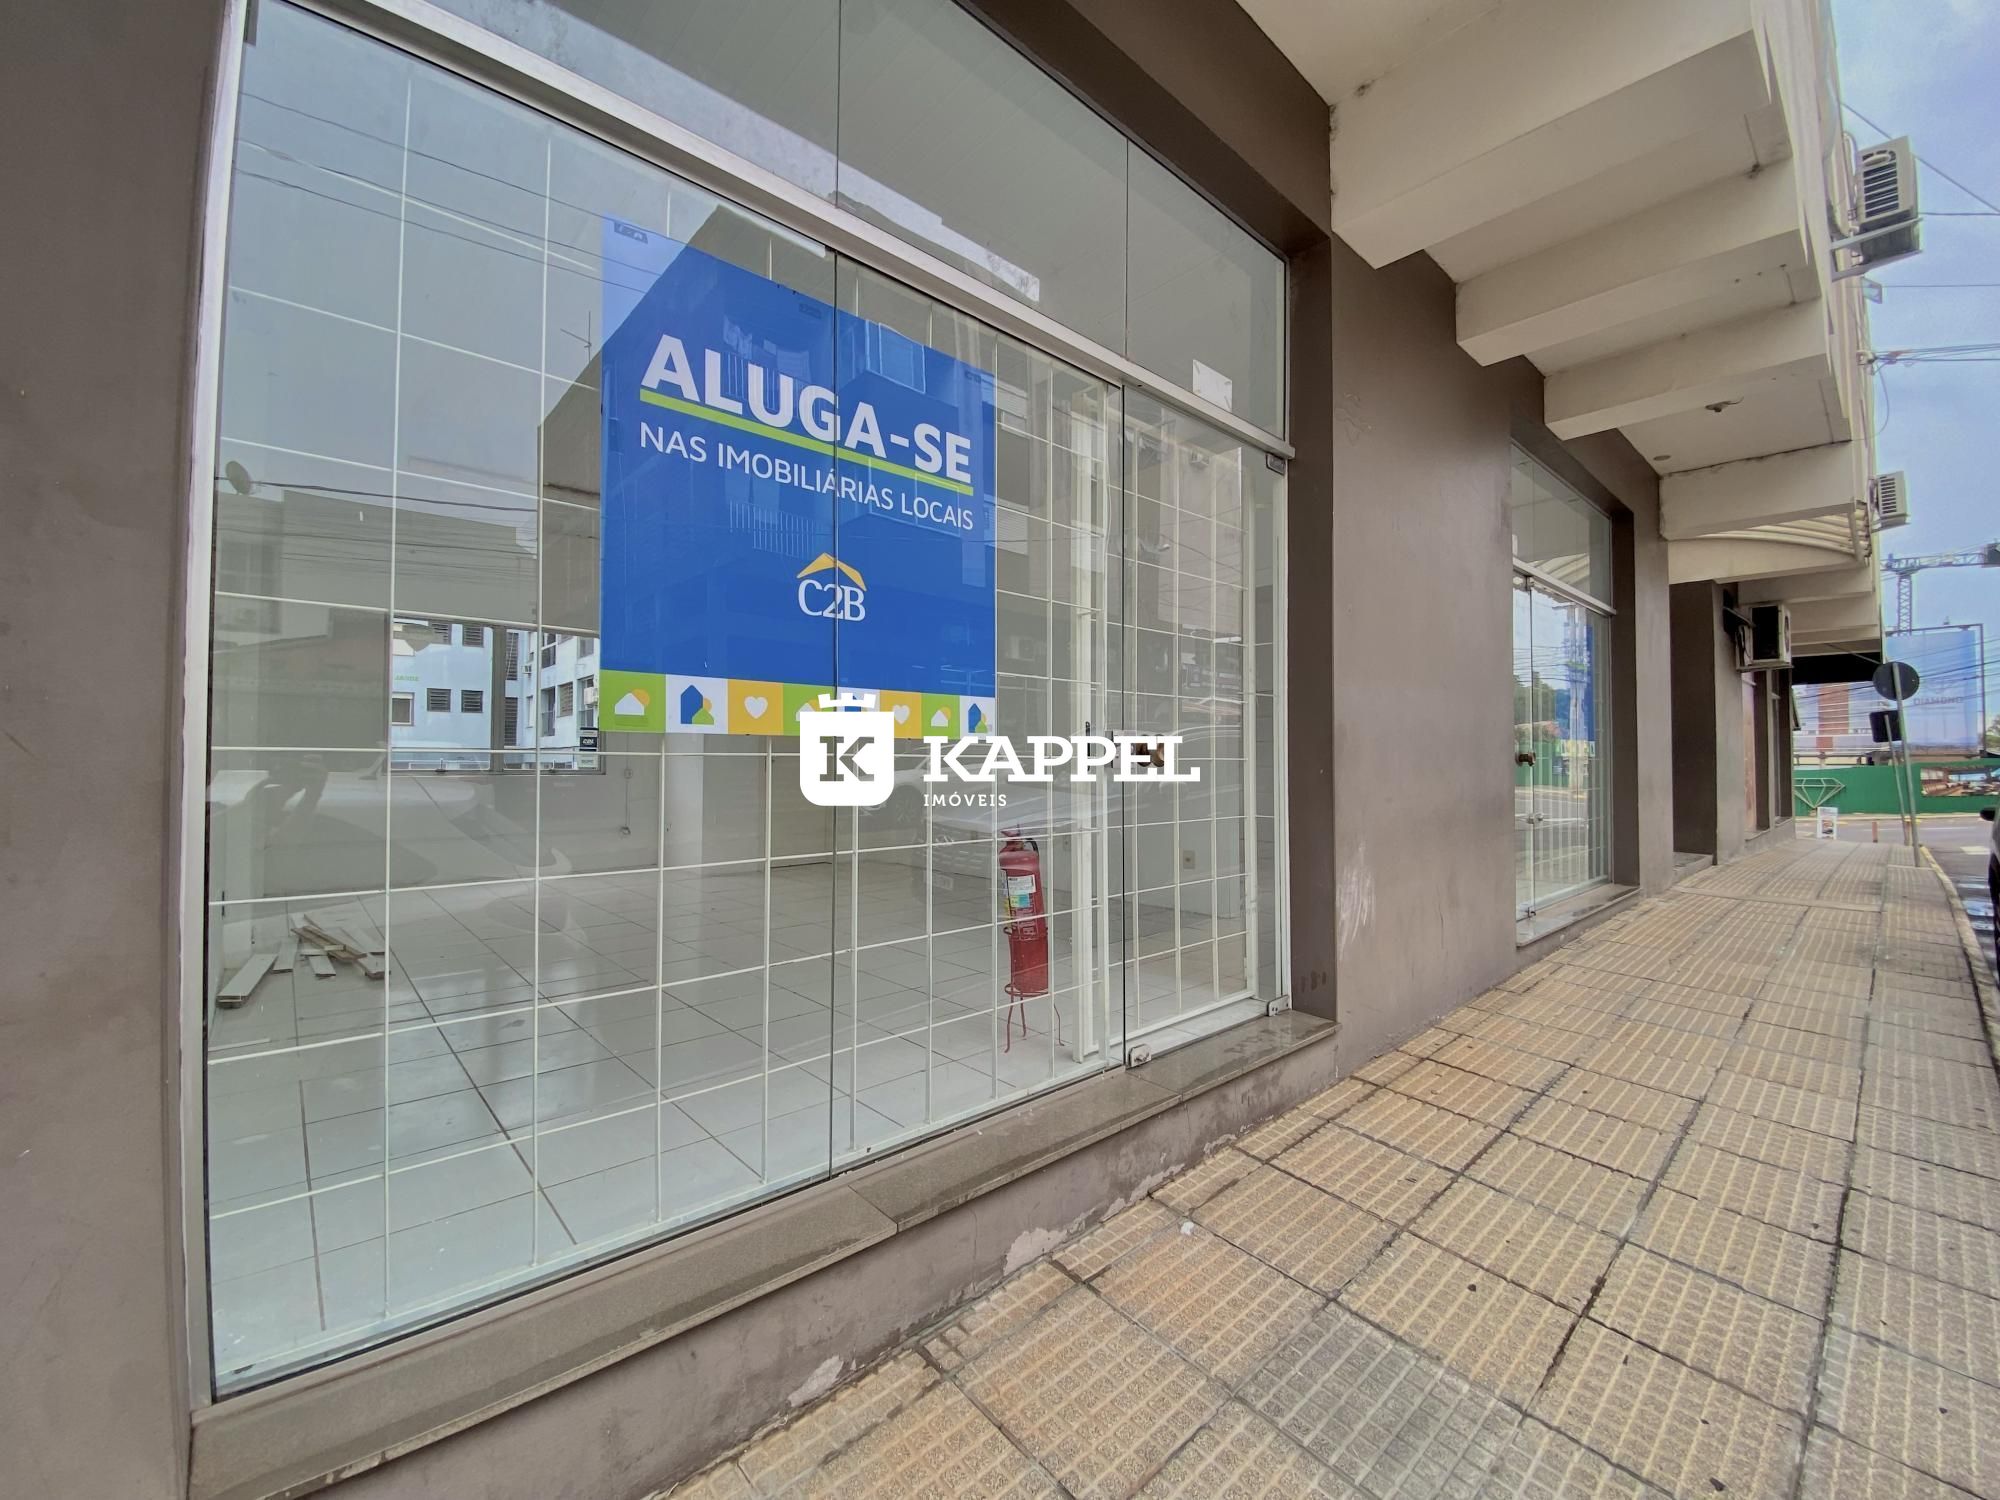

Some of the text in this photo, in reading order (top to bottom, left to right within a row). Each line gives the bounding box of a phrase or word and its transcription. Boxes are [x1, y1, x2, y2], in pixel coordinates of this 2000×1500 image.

[640, 333, 972, 484] ALUGA-SE
[640, 421, 974, 531] NAS IMOBILIÁRIAS LOCAIS
[798, 579, 866, 622] C2B
